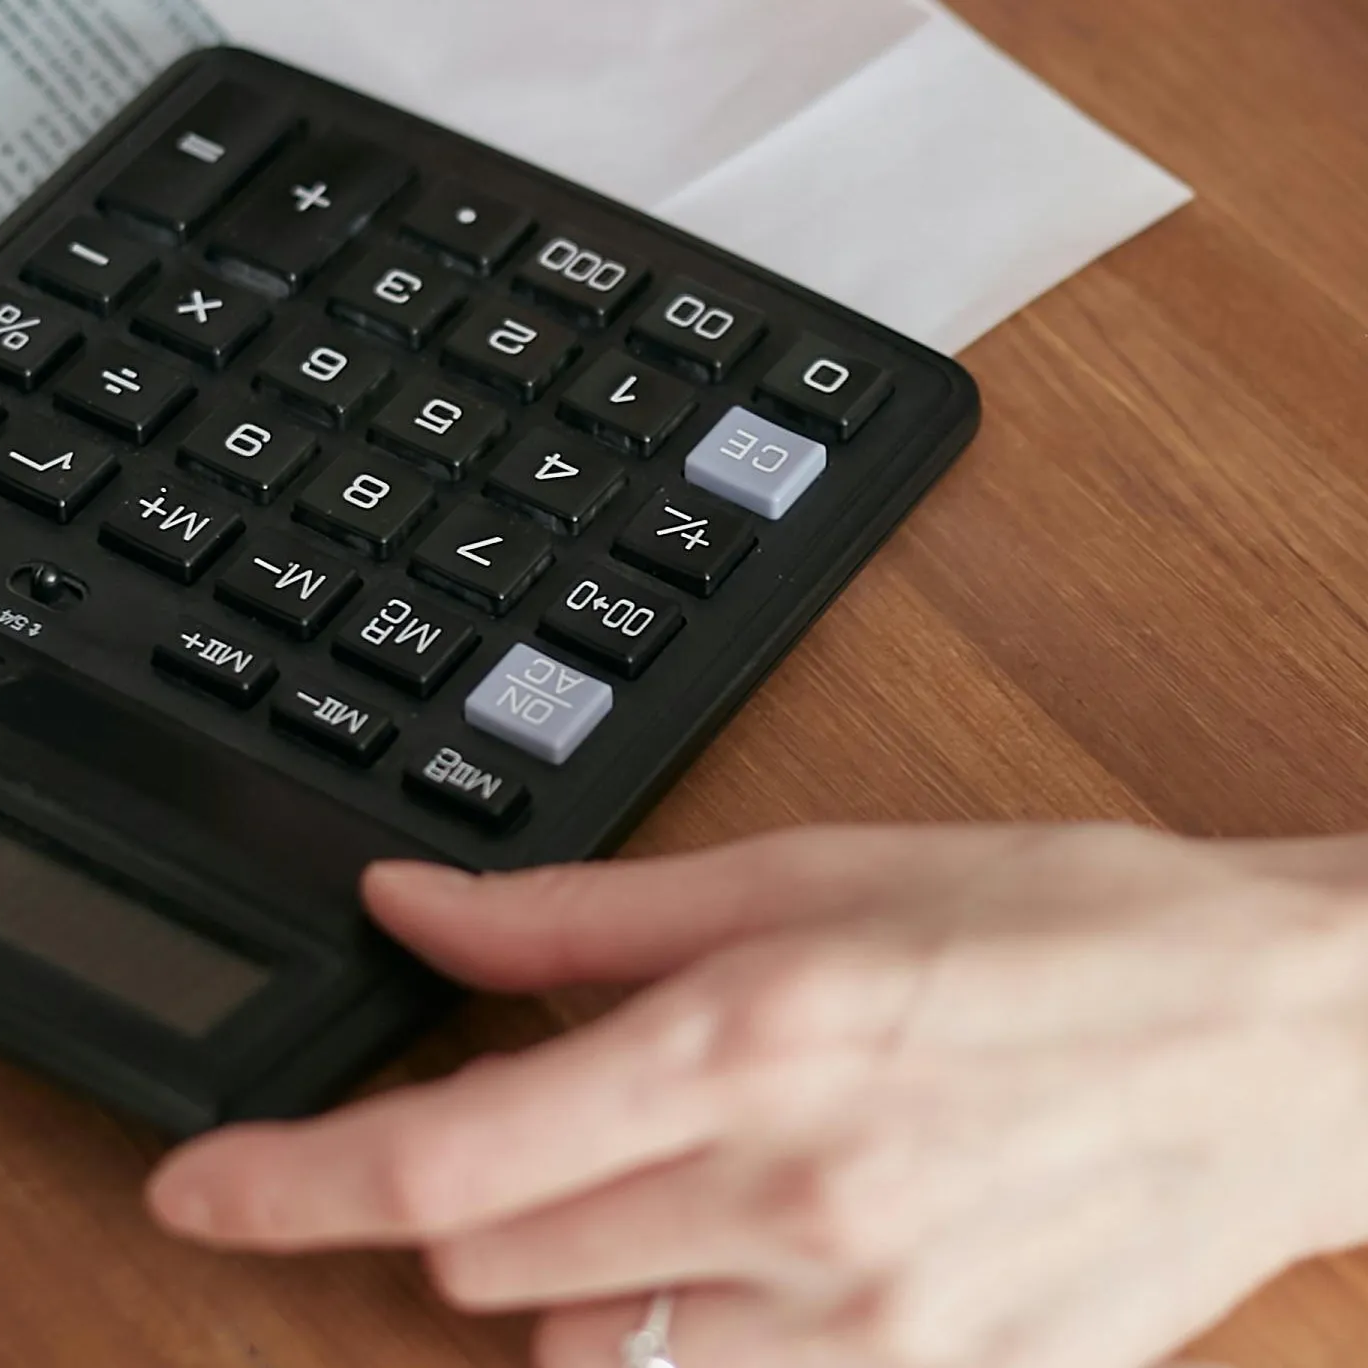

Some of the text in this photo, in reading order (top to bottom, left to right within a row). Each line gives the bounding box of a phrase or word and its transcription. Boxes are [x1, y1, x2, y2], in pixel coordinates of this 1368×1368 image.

[539, 239, 626, 291] 000
[375, 270, 422, 304] 3
[665, 295, 734, 340] 00
[489, 319, 537, 355] 2
[301, 347, 348, 381] 6
[803, 359, 849, 393] 0
[610, 376, 637, 403] 1
[414, 399, 462, 435] 5
[225, 423, 271, 457] 9
[716, 428, 791, 475] CE
[534, 453, 579, 480] 4
[342, 474, 390, 509] 8
[456, 536, 504, 567] 7
[521, 654, 582, 700] AC
[494, 685, 554, 729] ON
